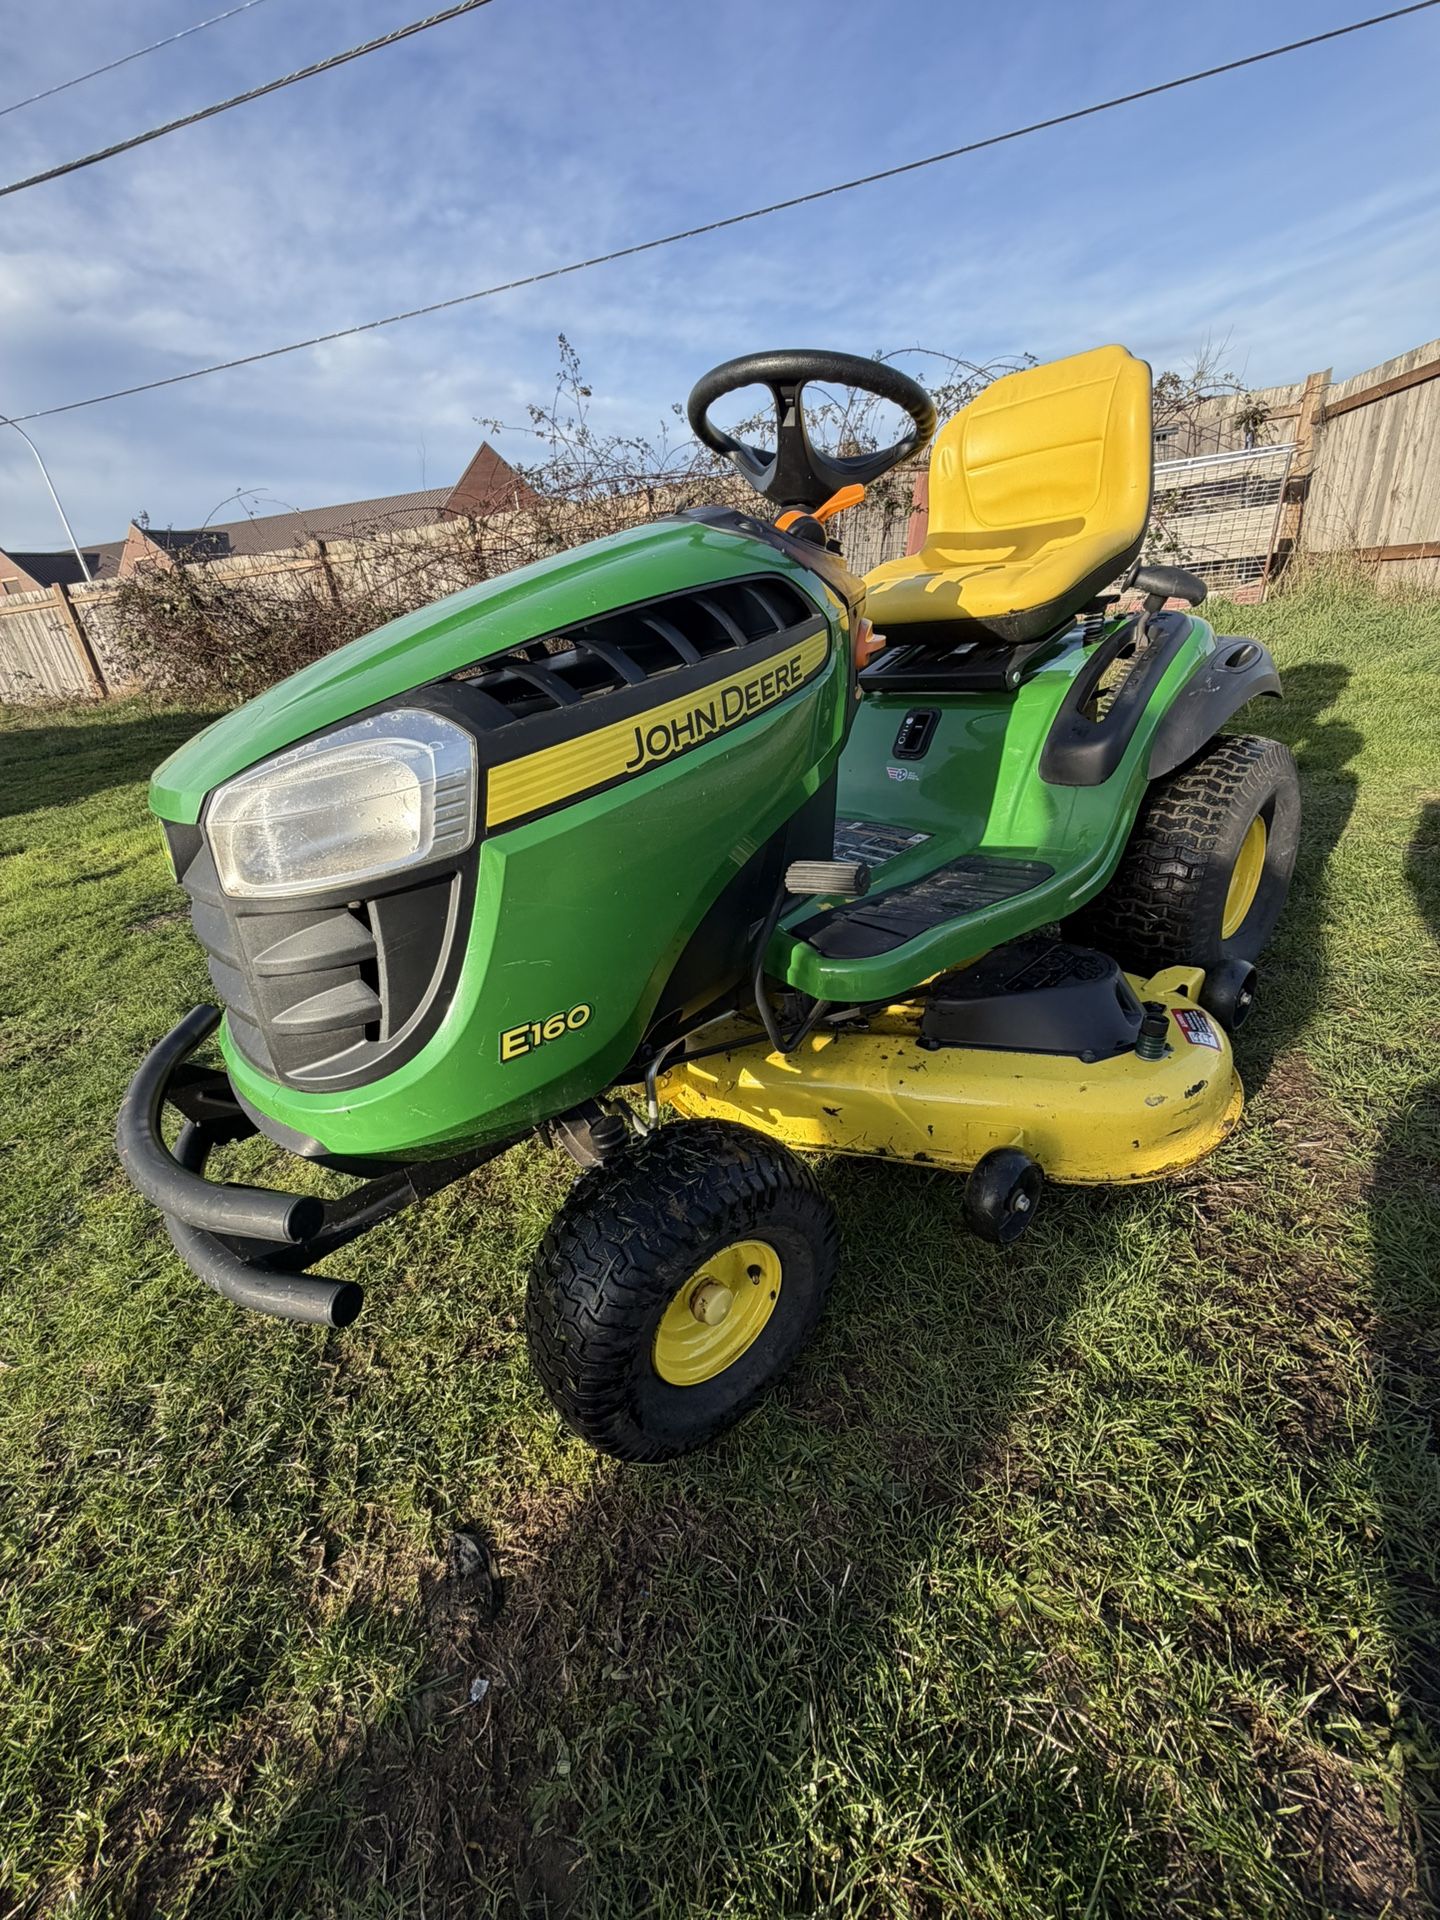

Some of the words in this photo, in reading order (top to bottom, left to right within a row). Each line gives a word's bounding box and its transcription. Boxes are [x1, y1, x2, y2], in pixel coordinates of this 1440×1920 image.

[626, 702, 717, 768] JOHN
[721, 655, 802, 723] DEERE
[501, 1003, 591, 1062] E160
